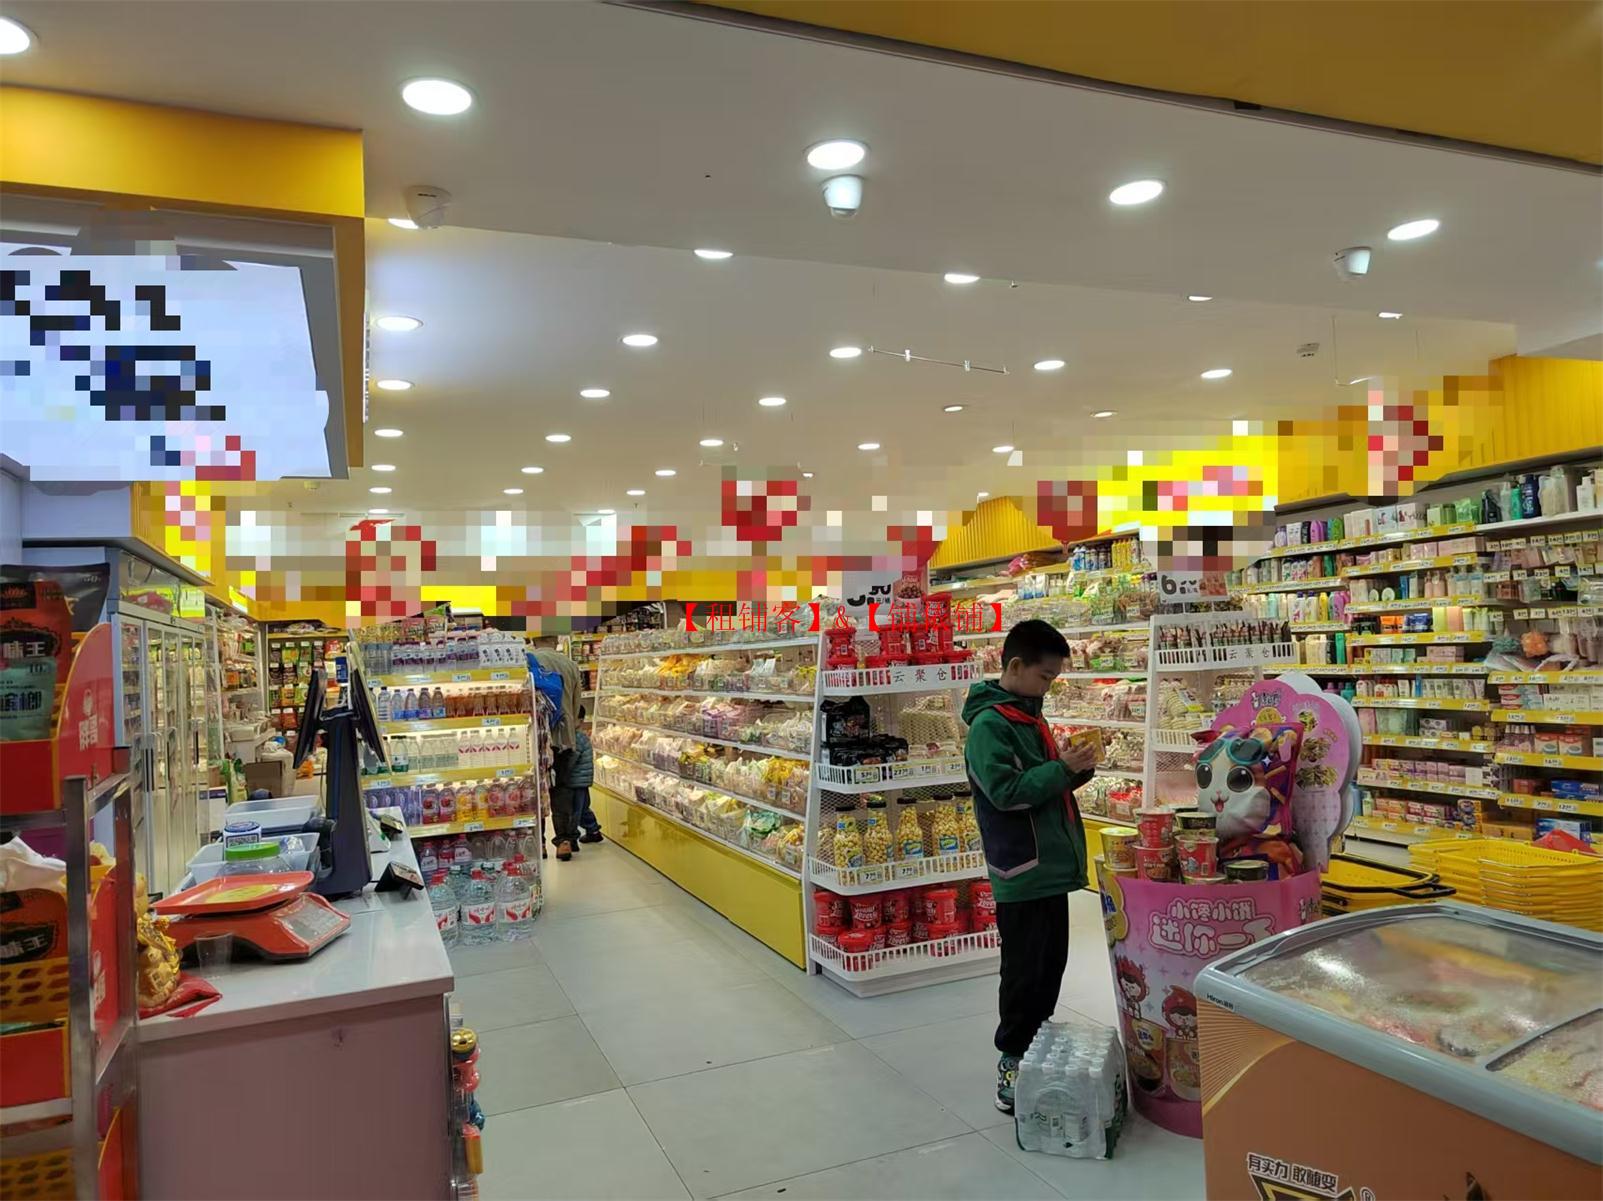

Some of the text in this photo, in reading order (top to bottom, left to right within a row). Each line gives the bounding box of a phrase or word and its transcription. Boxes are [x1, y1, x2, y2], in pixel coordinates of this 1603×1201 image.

[1249, 1154, 1337, 1192] 有实力 敢随变
